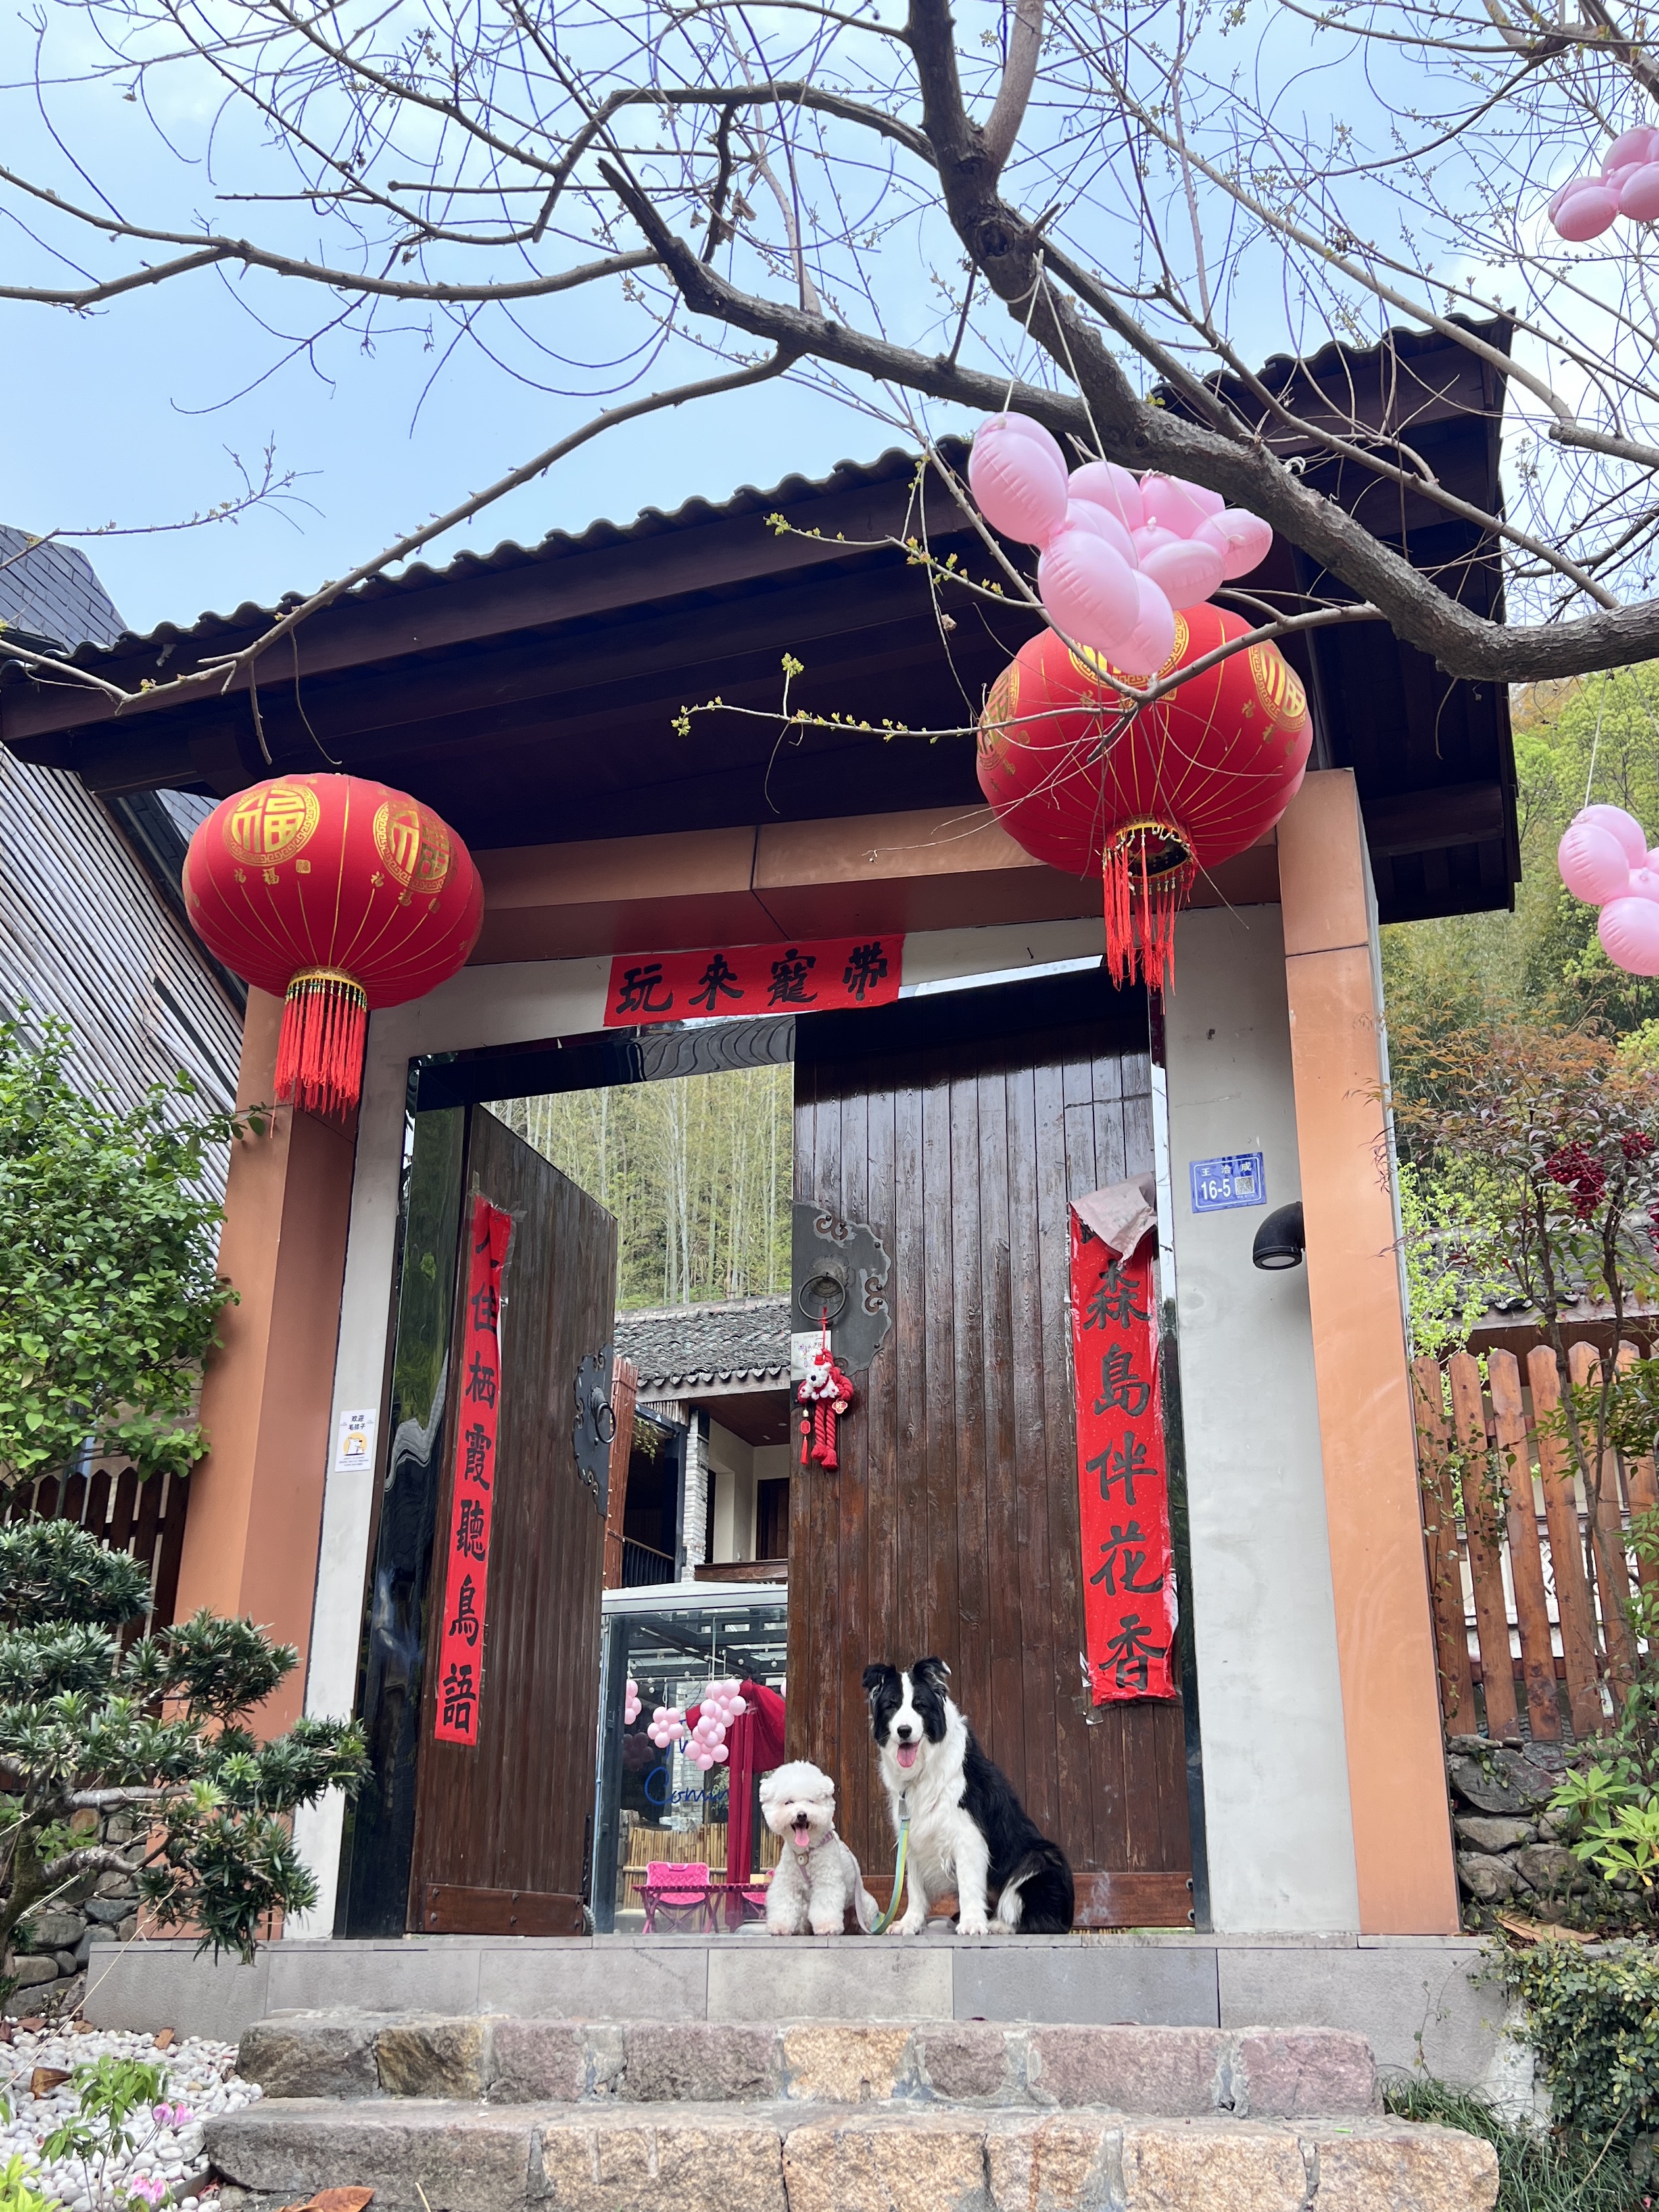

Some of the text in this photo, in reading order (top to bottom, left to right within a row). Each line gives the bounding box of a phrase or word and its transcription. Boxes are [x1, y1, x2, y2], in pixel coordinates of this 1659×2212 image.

[231, 789, 306, 853] 福
[1201, 1178, 1231, 1200] 16-5
[1080, 1221, 1168, 1690] 森島伴花香
